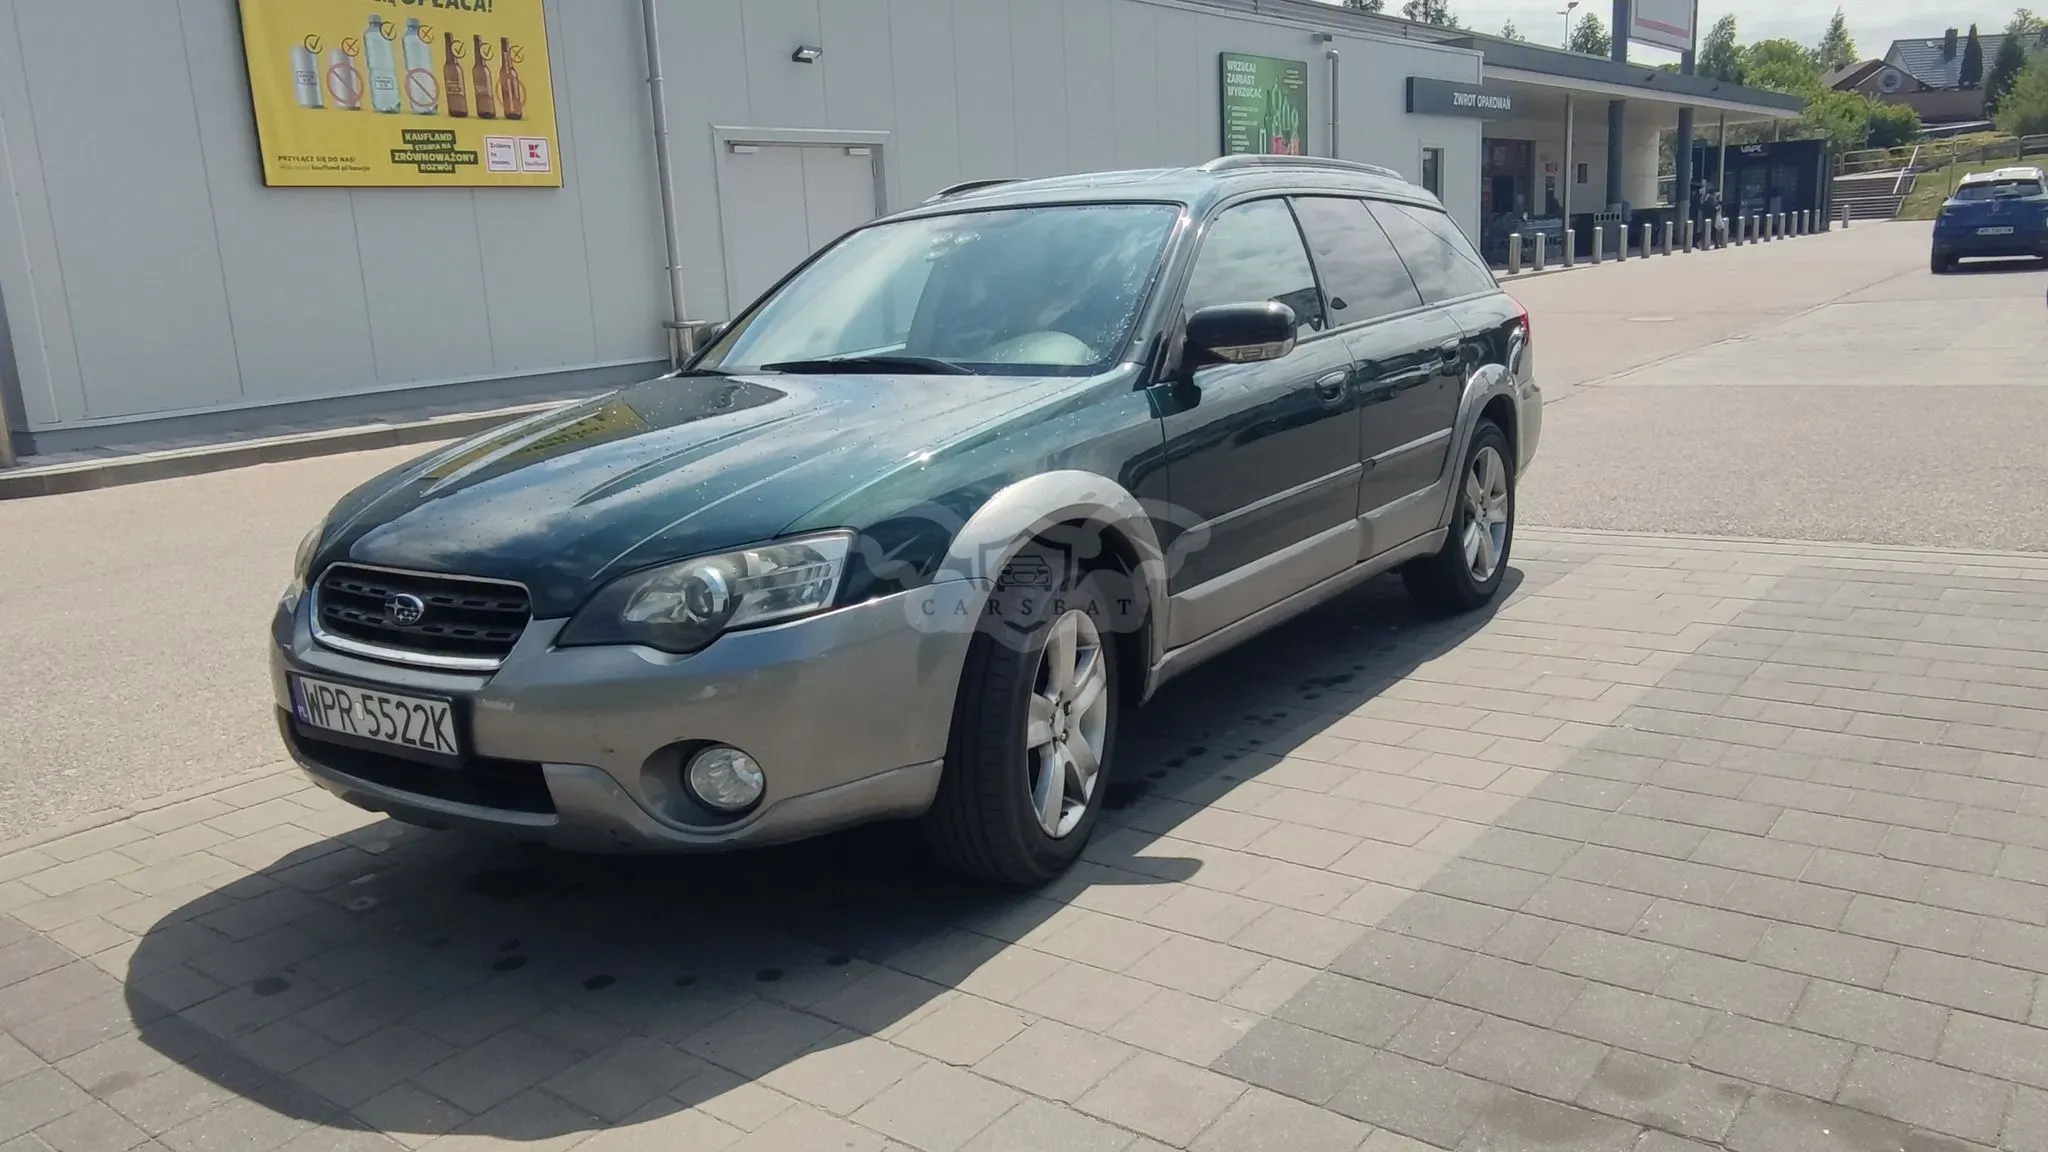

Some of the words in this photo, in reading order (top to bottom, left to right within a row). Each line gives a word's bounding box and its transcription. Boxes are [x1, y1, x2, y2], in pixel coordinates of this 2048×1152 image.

[1227, 73, 1255, 85] ZAMIAST
[1453, 92, 1476, 106] ZWROT
[1477, 95, 1511, 110] OPAKOWAŃ
[404, 132, 453, 141] KAUFLAND
[394, 152, 475, 162] ZRÓWNOWAŻONY
[420, 163, 452, 171] ROZWÓJ
[302, 681, 358, 734] WPR
[360, 694, 457, 753] 5522K
